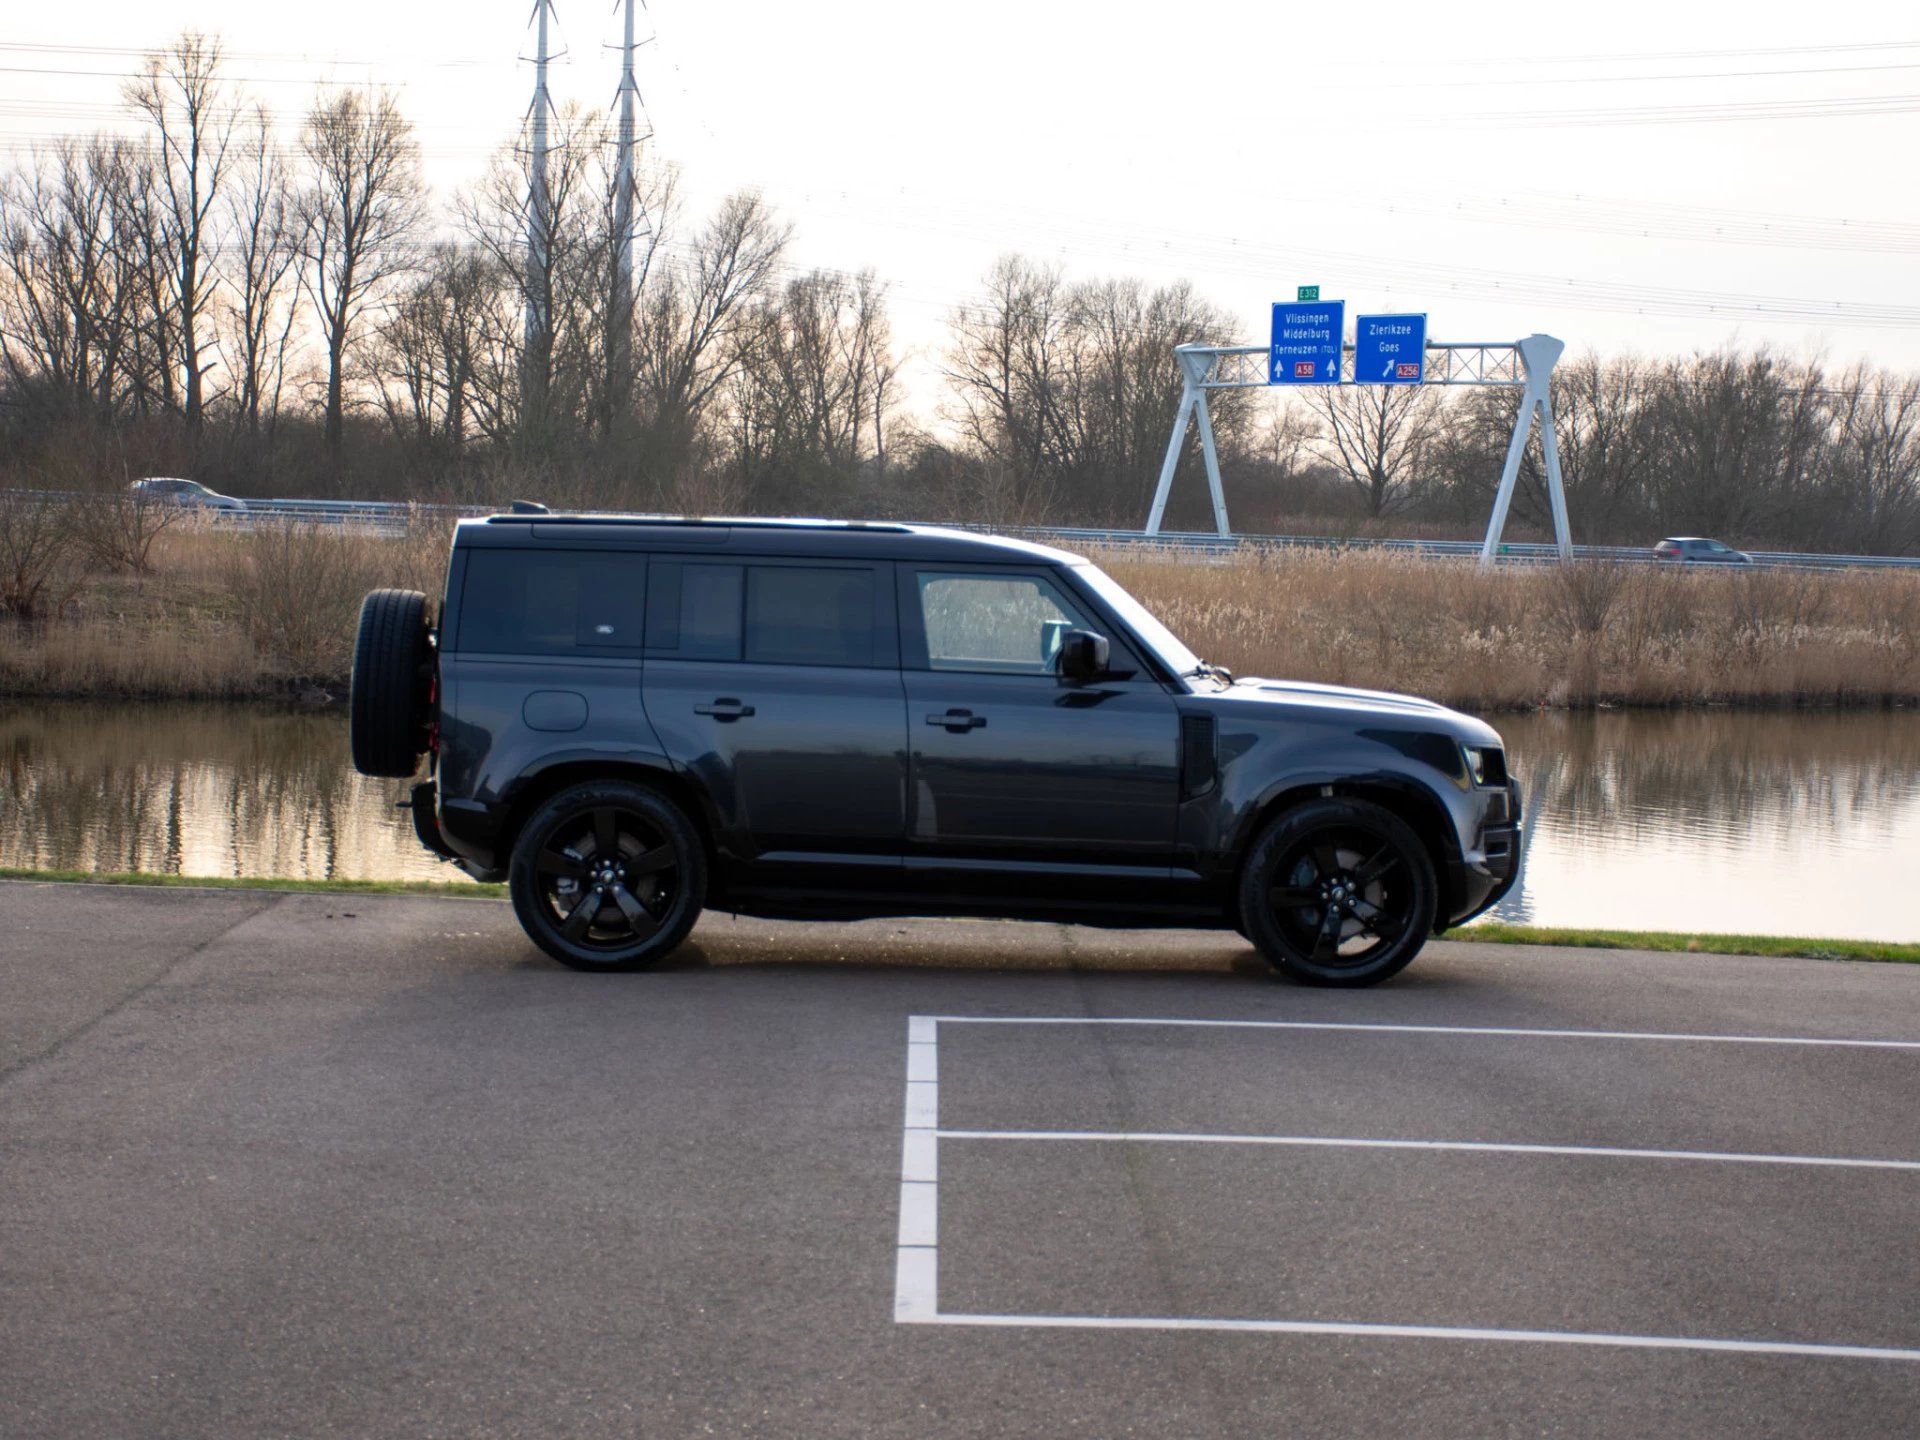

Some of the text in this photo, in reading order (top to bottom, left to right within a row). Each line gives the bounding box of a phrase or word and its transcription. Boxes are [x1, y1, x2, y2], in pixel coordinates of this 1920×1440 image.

[1285, 313, 1329, 326] Vlissingen
[1283, 328, 1330, 341] Middelburg
[1369, 324, 1411, 335] Zierikzee
[1274, 344, 1317, 355] Terneuzen
[1379, 341, 1400, 352] Goes
